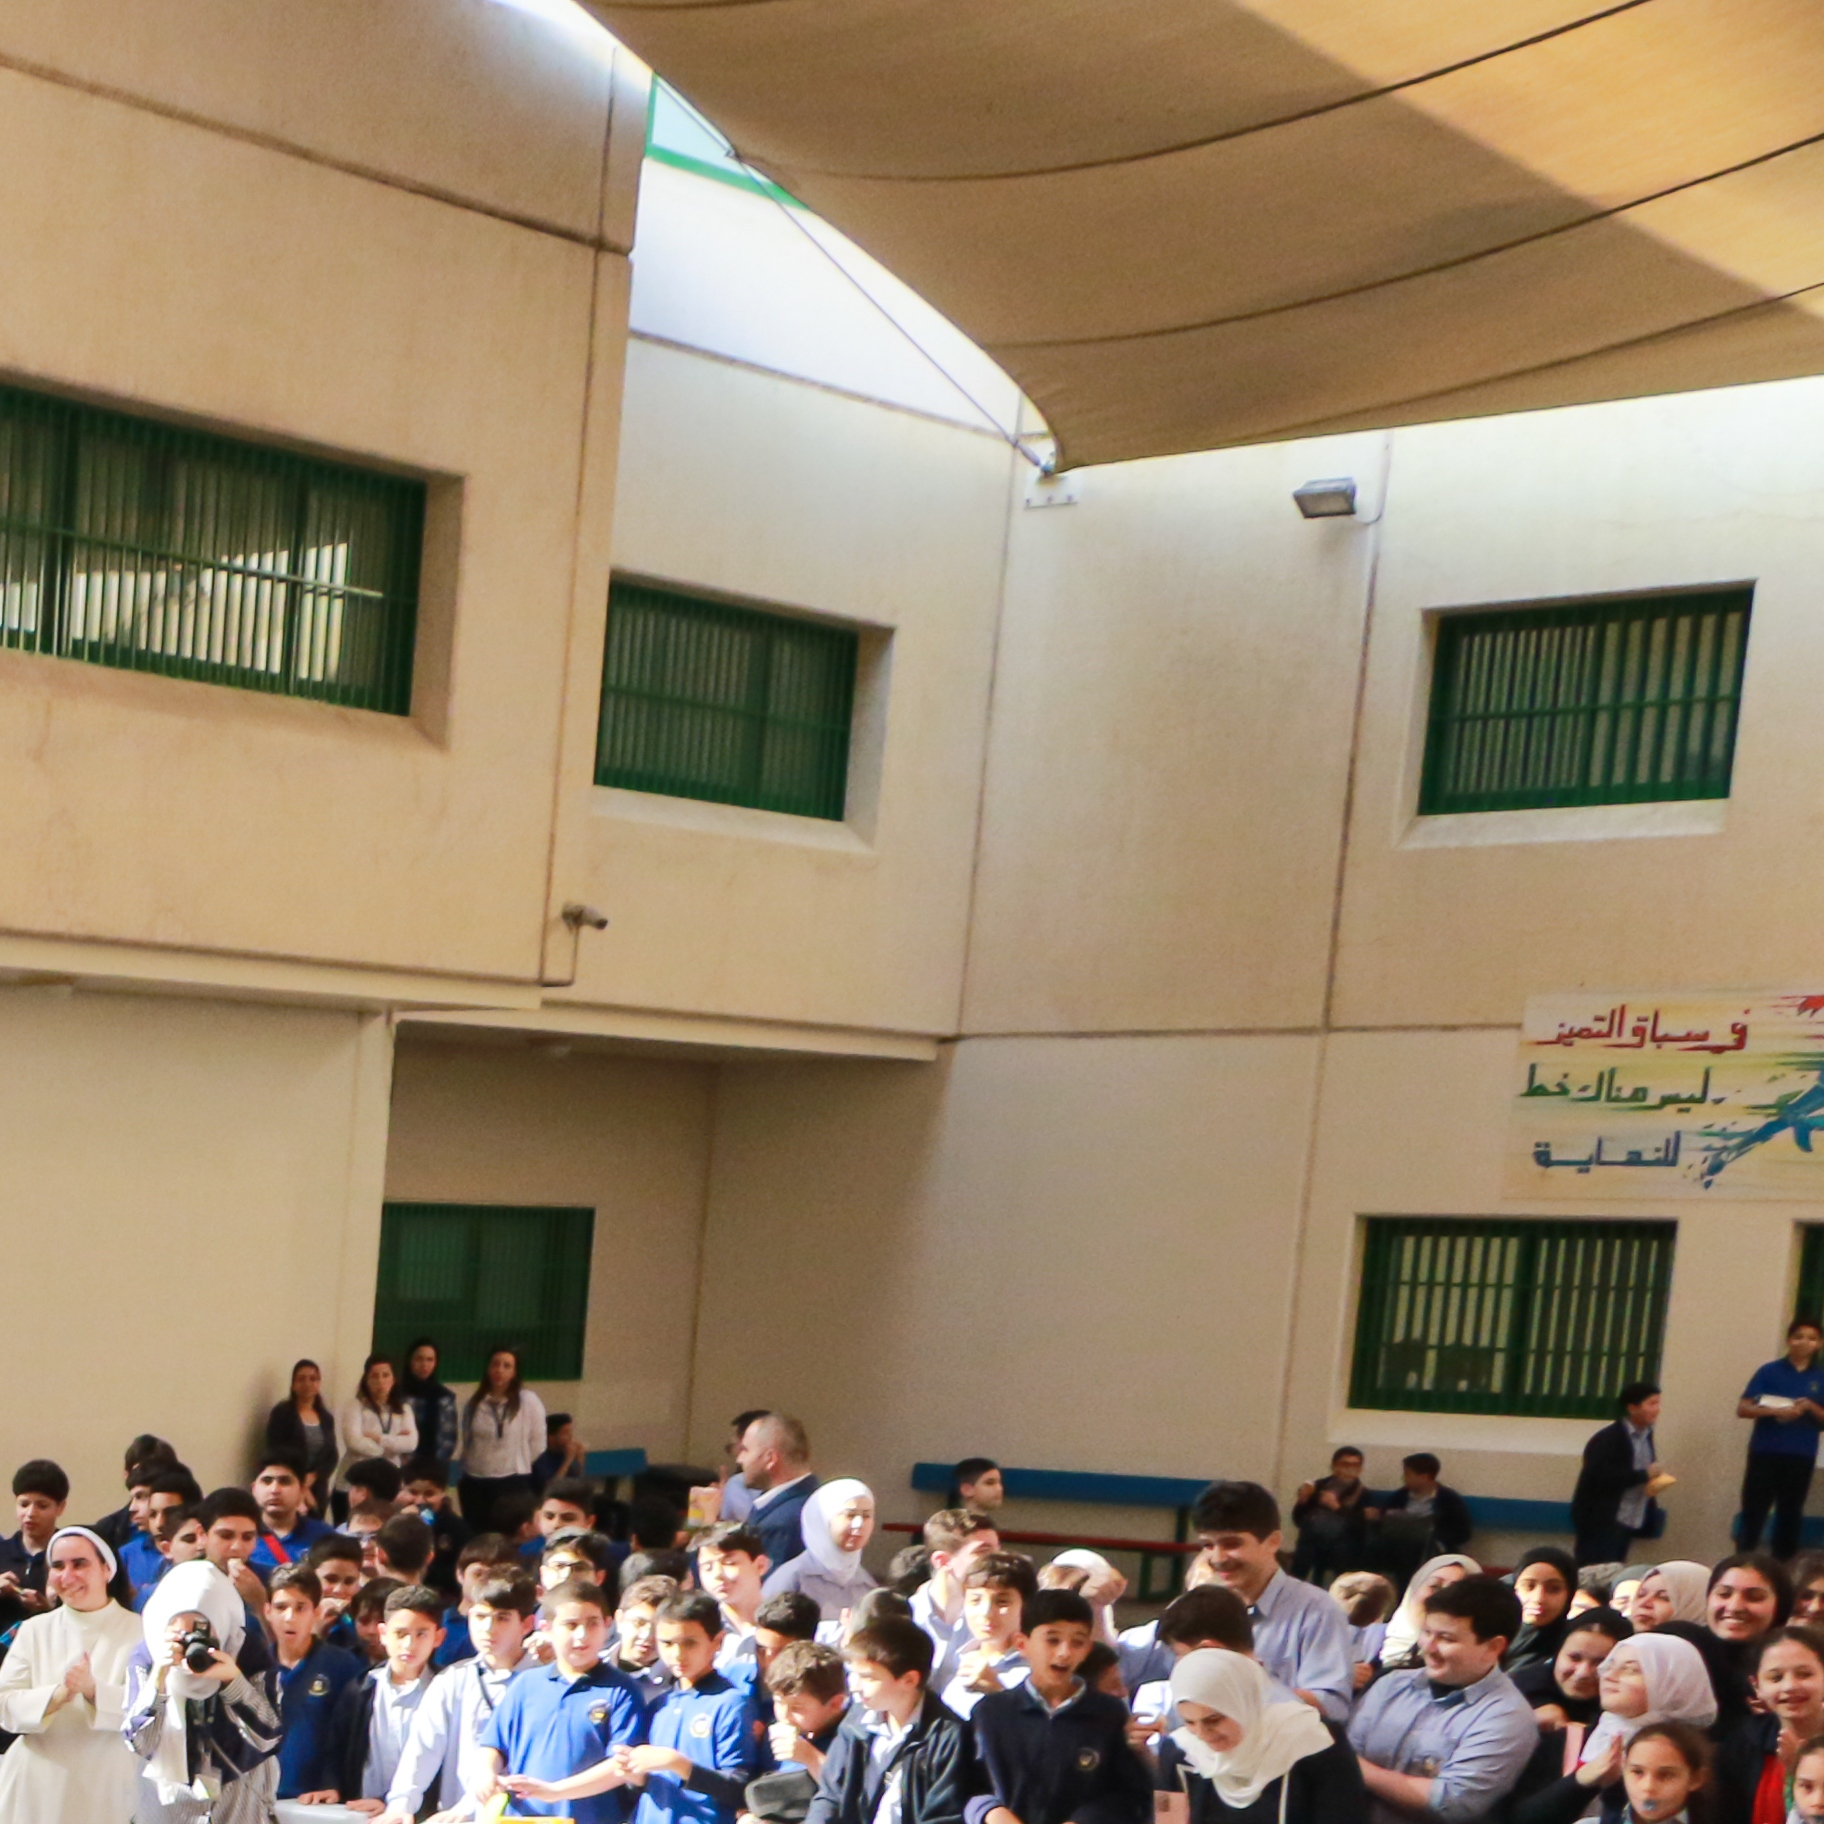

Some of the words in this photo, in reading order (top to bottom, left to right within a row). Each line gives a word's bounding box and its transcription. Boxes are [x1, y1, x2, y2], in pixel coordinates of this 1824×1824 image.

[1530, 1004, 1627, 1048] التميز
[1603, 1009, 1710, 1048] سباق
[1677, 1009, 1750, 1054] في
[1519, 1063, 1571, 1098] خط
[1571, 1067, 1649, 1103] هناك
[1613, 1066, 1713, 1113] ليس
[1533, 1131, 1682, 1174] للنهاية
